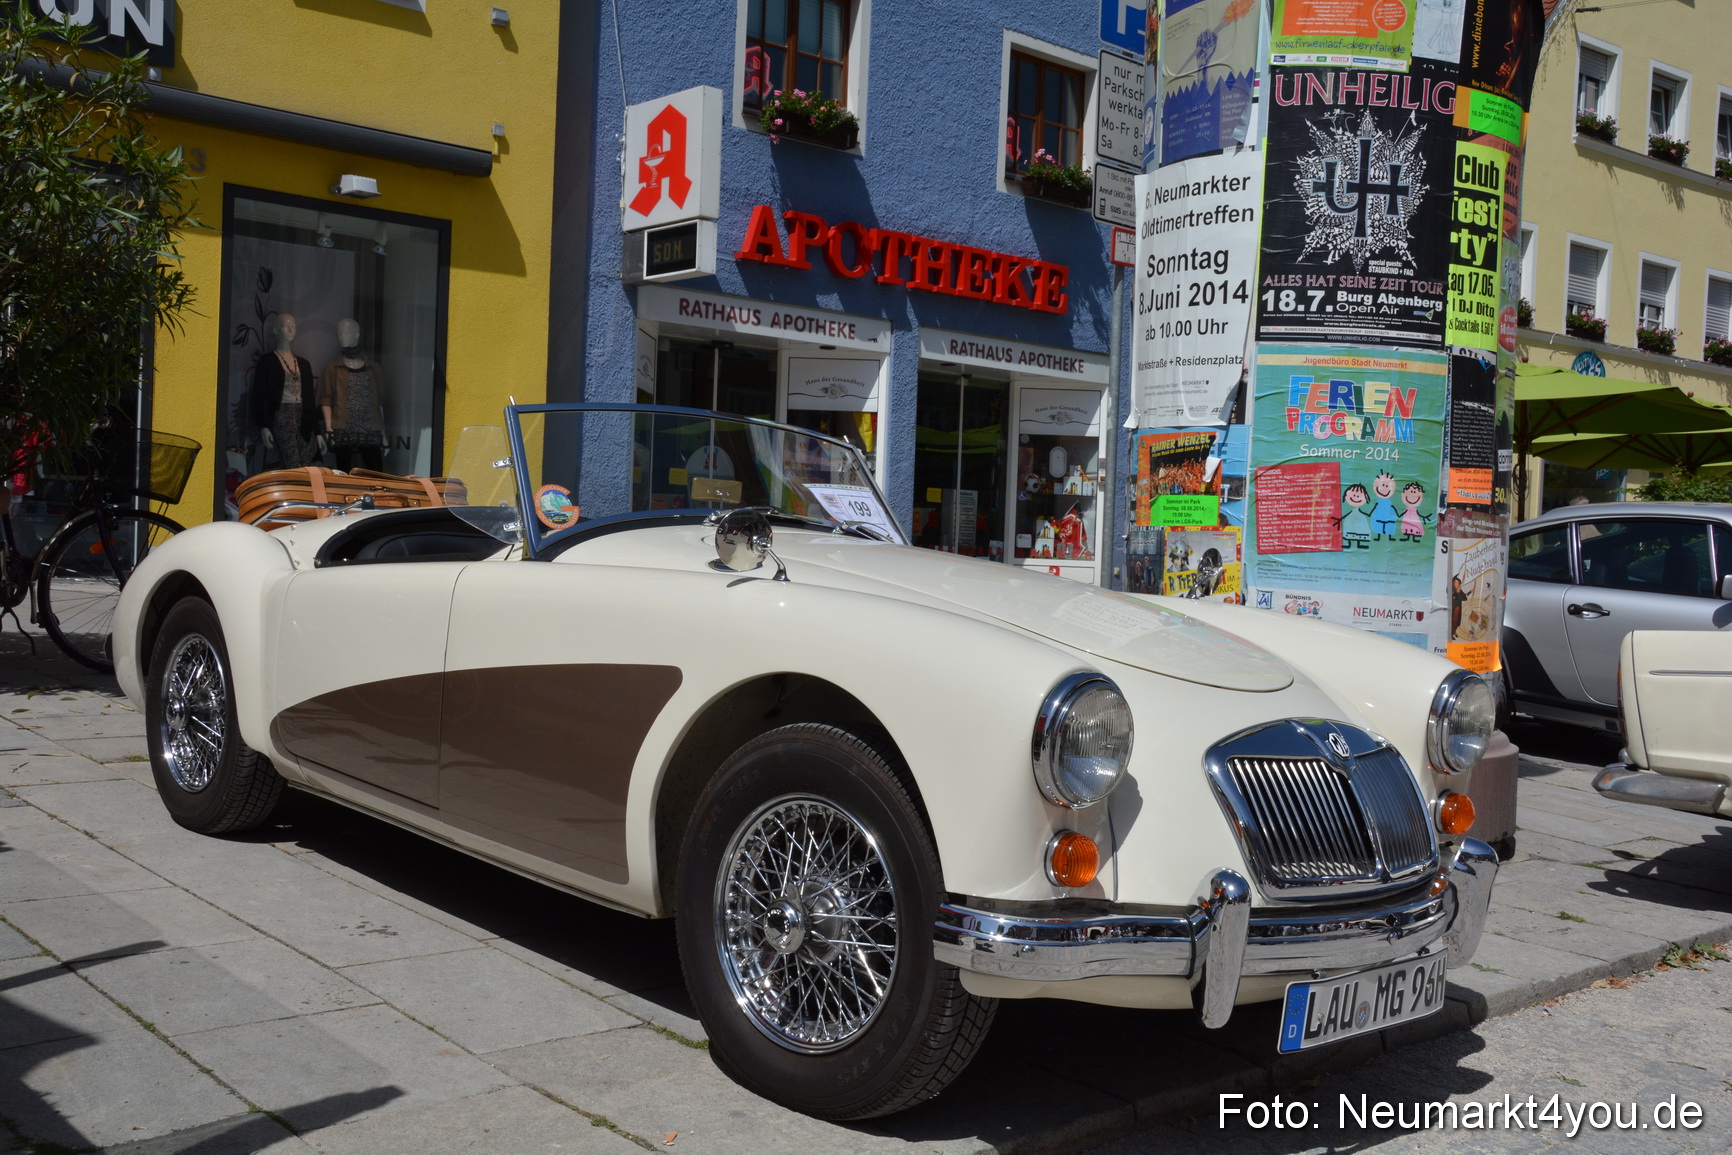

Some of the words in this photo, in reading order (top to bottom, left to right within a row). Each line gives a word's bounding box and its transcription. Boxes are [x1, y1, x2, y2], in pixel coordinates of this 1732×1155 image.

[1113, 66, 1132, 80] nur
[1275, 72, 1456, 115] UNHEILIG
[1102, 116, 1130, 136] Mo-Fr
[1101, 134, 1112, 149] Sa
[1456, 154, 1500, 191] Club
[1099, 186, 1113, 196] Anruf
[1154, 175, 1251, 206] Neumarkter
[1110, 205, 1122, 215] SMS
[1141, 204, 1254, 240] Oldtimertreffen
[734, 204, 1069, 315] APOTHEKE
[1146, 247, 1229, 278] Sonntag
[1262, 275, 1303, 287] ALLES
[1306, 275, 1337, 287] HAT
[1339, 275, 1377, 289] SEINE
[1380, 278, 1408, 291] ZEIT
[1410, 280, 1444, 296] TOUR
[1468, 272, 1495, 299] 17.05.
[1139, 284, 1181, 316] 8.Juni
[1188, 279, 1249, 307] 2014
[1262, 290, 1334, 312] 18.7.
[1336, 291, 1373, 306] Burg
[1377, 293, 1443, 312] Abenberg
[1336, 302, 1376, 314] Open
[1379, 305, 1400, 315] Air
[1459, 299, 1473, 314] DJ
[1476, 301, 1495, 318] Dito
[679, 298, 762, 327] RATHAUS
[770, 312, 857, 341] APOTHEKE
[1145, 324, 1156, 341] ab
[1160, 320, 1192, 339] 10.00
[1198, 318, 1229, 335] Uhr
[1454, 317, 1480, 334] Cocktails
[950, 339, 1013, 363] RATHAUS
[1018, 351, 1085, 374] APOTHEKE
[1175, 354, 1244, 367] Residenzplatz
[1303, 356, 1350, 366] Jugendbüro
[1351, 358, 1371, 367] Stadt
[1373, 360, 1408, 370] Neumarkt
[805, 377, 821, 386] Haus
[832, 376, 866, 388] Gesundheit
[1288, 375, 1418, 419] FERIEN
[1058, 405, 1089, 416] Gesundheit
[1285, 407, 1415, 444] PROGRAMM
[1151, 439, 1176, 453] RAINER
[1178, 434, 1211, 448] WENZEL
[1299, 444, 1360, 460] Sommer
[1366, 447, 1400, 462] 2014
[848, 500, 872, 517] 199
[1353, 606, 1414, 621] NEUMARKT
[1304, 981, 1359, 1039] LAU
[1372, 970, 1407, 1023] MG
[1410, 955, 1447, 1013] 96H
[1288, 1024, 1297, 1039] D
